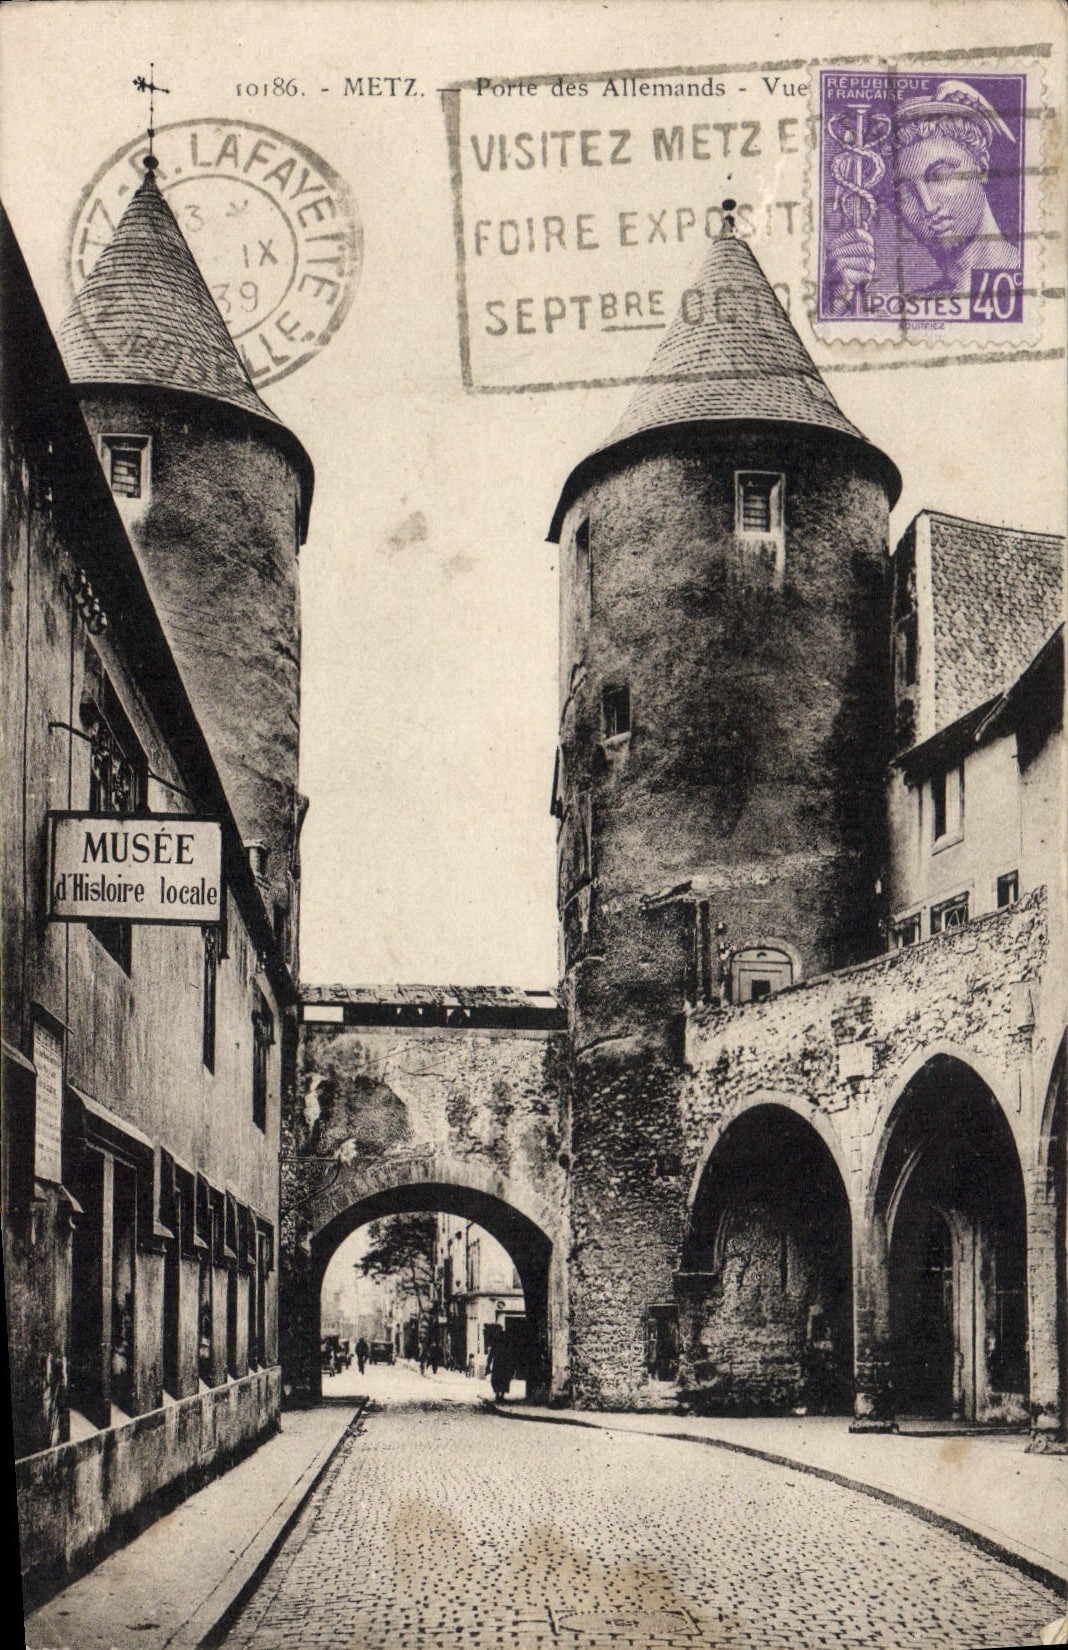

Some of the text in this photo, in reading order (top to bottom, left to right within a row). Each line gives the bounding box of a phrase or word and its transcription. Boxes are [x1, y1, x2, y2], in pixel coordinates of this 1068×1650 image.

[868, 295, 963, 317] POSTES
[81, 826, 196, 865] MUSÉE
[160, 875, 218, 905] locale
